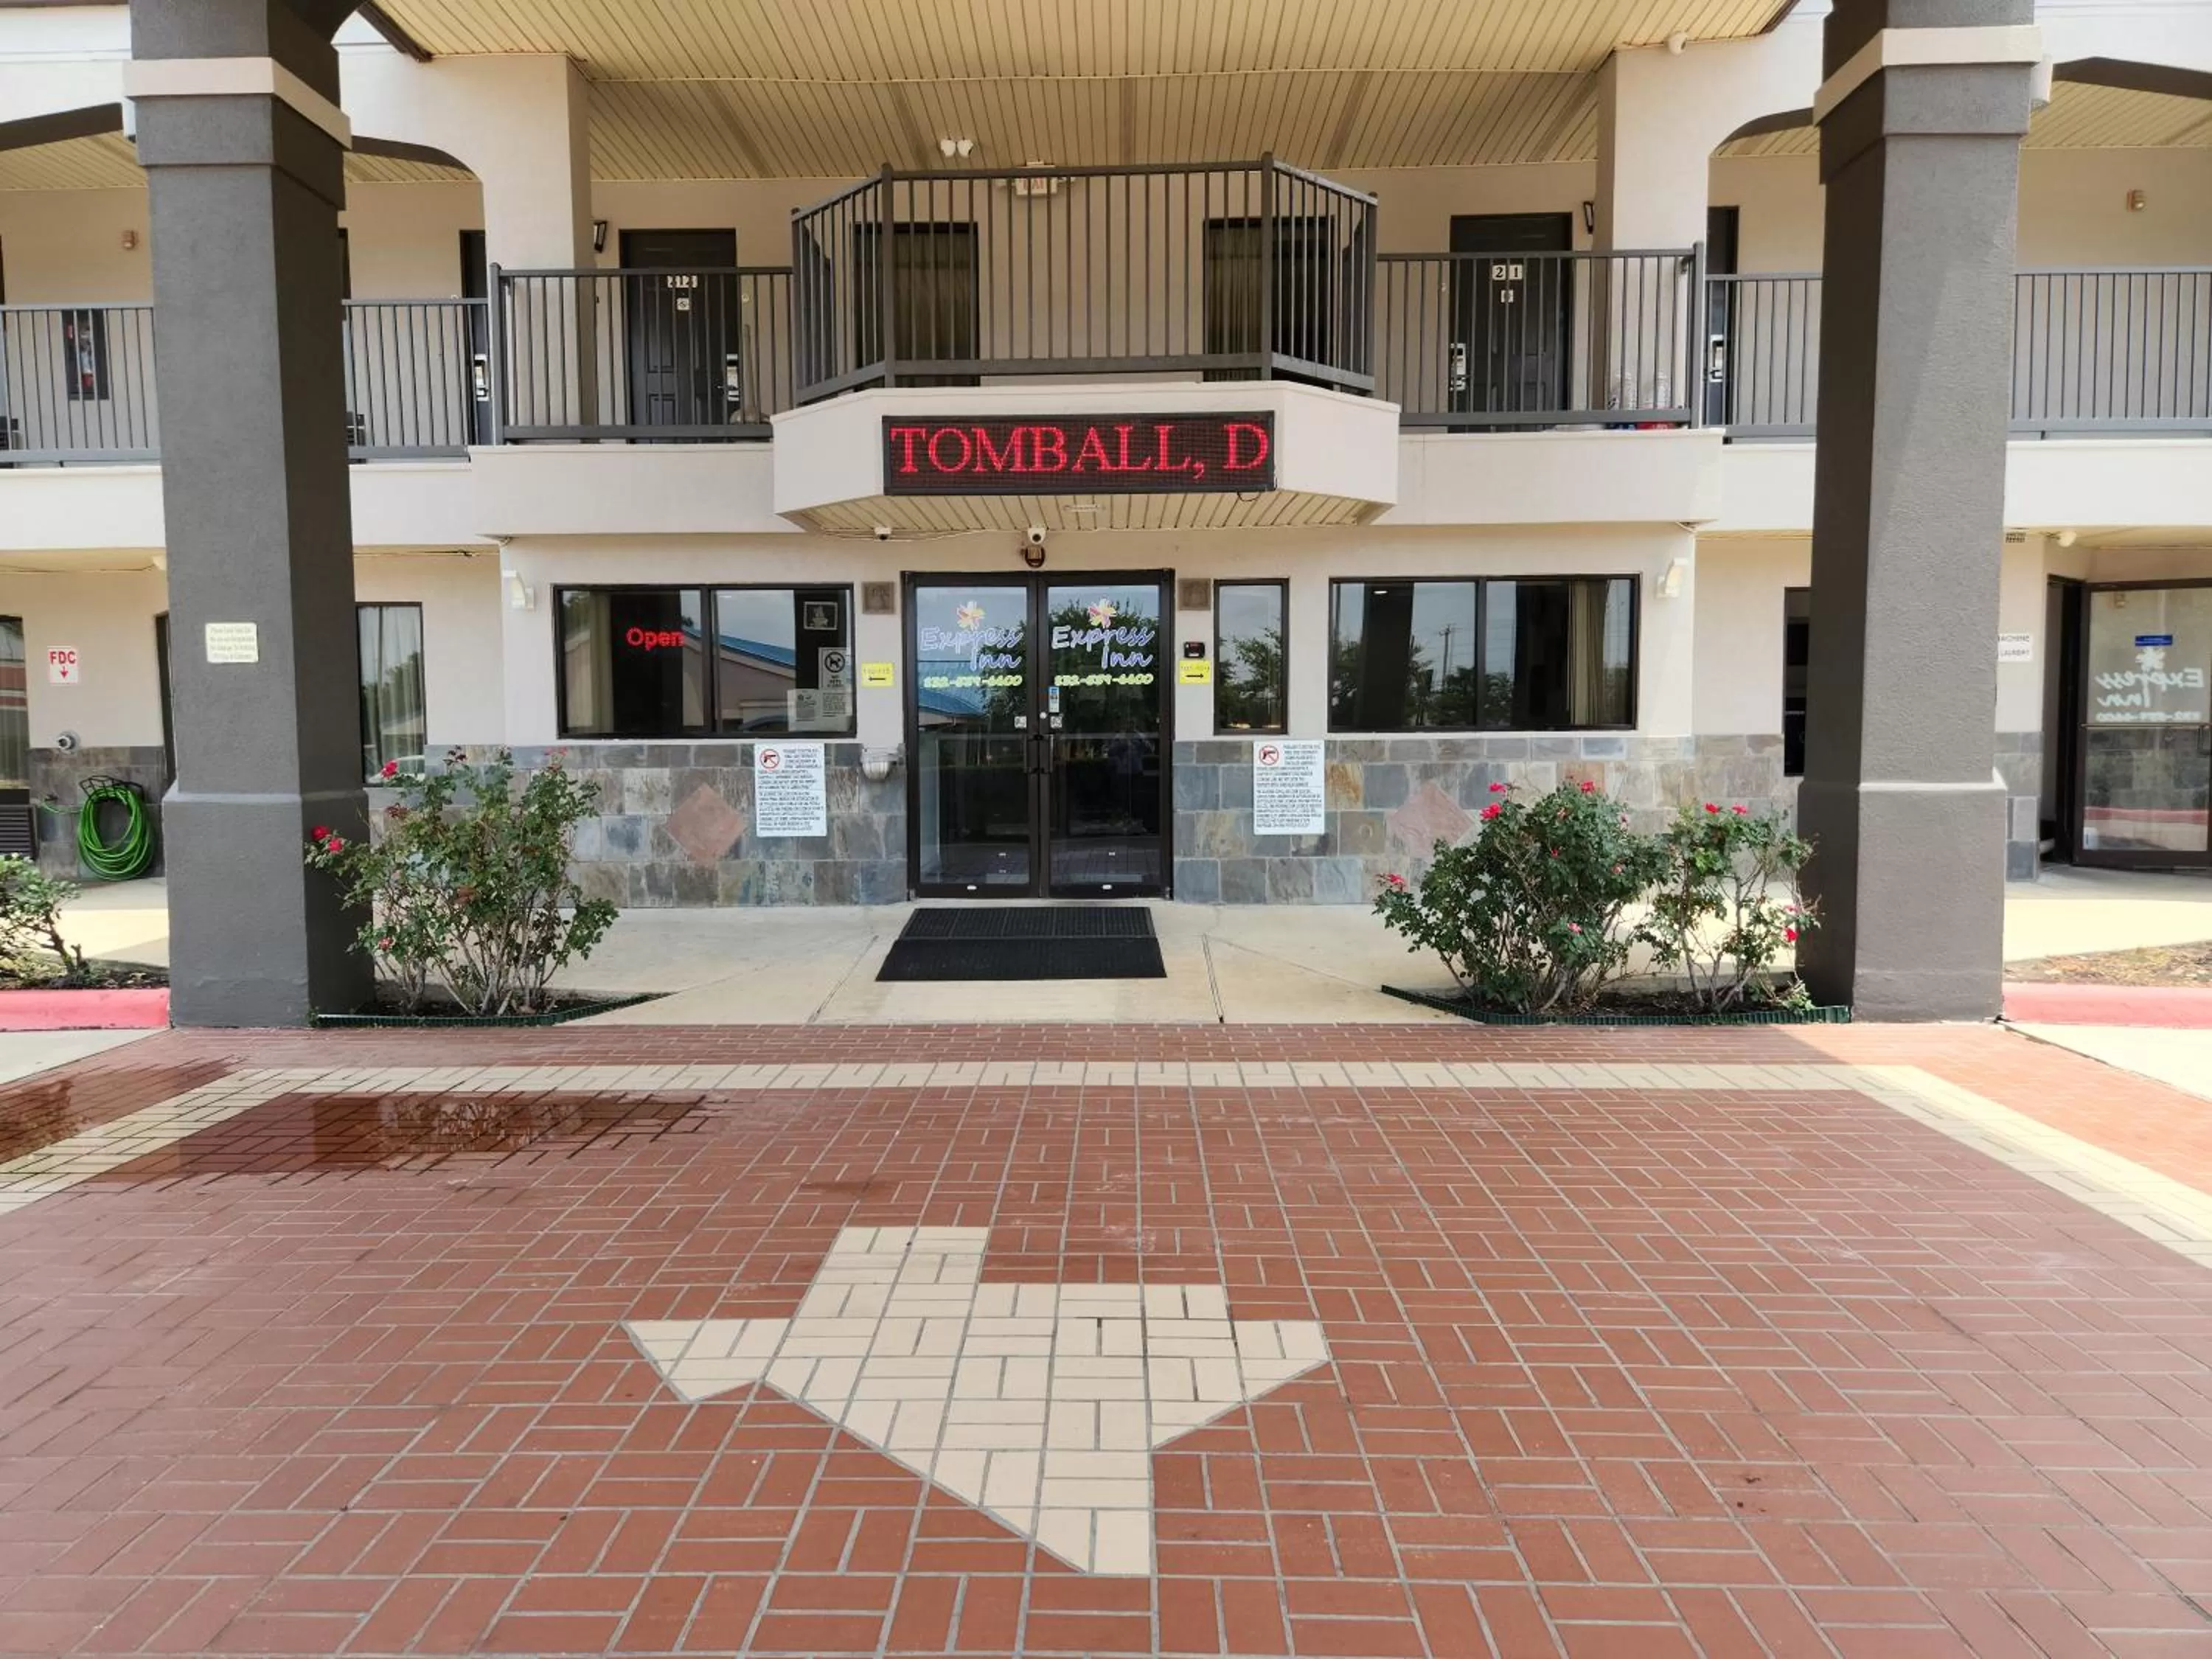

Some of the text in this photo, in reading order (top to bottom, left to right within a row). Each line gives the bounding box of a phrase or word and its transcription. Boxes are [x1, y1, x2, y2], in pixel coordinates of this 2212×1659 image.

[890, 423, 1269, 479] TOMBALL, D
[627, 627, 684, 651] Open
[921, 627, 1023, 654] Express
[1051, 625, 1155, 652] Express
[49, 651, 76, 664] FDC
[969, 644, 1021, 671] Inn
[1101, 644, 1154, 669] Inn
